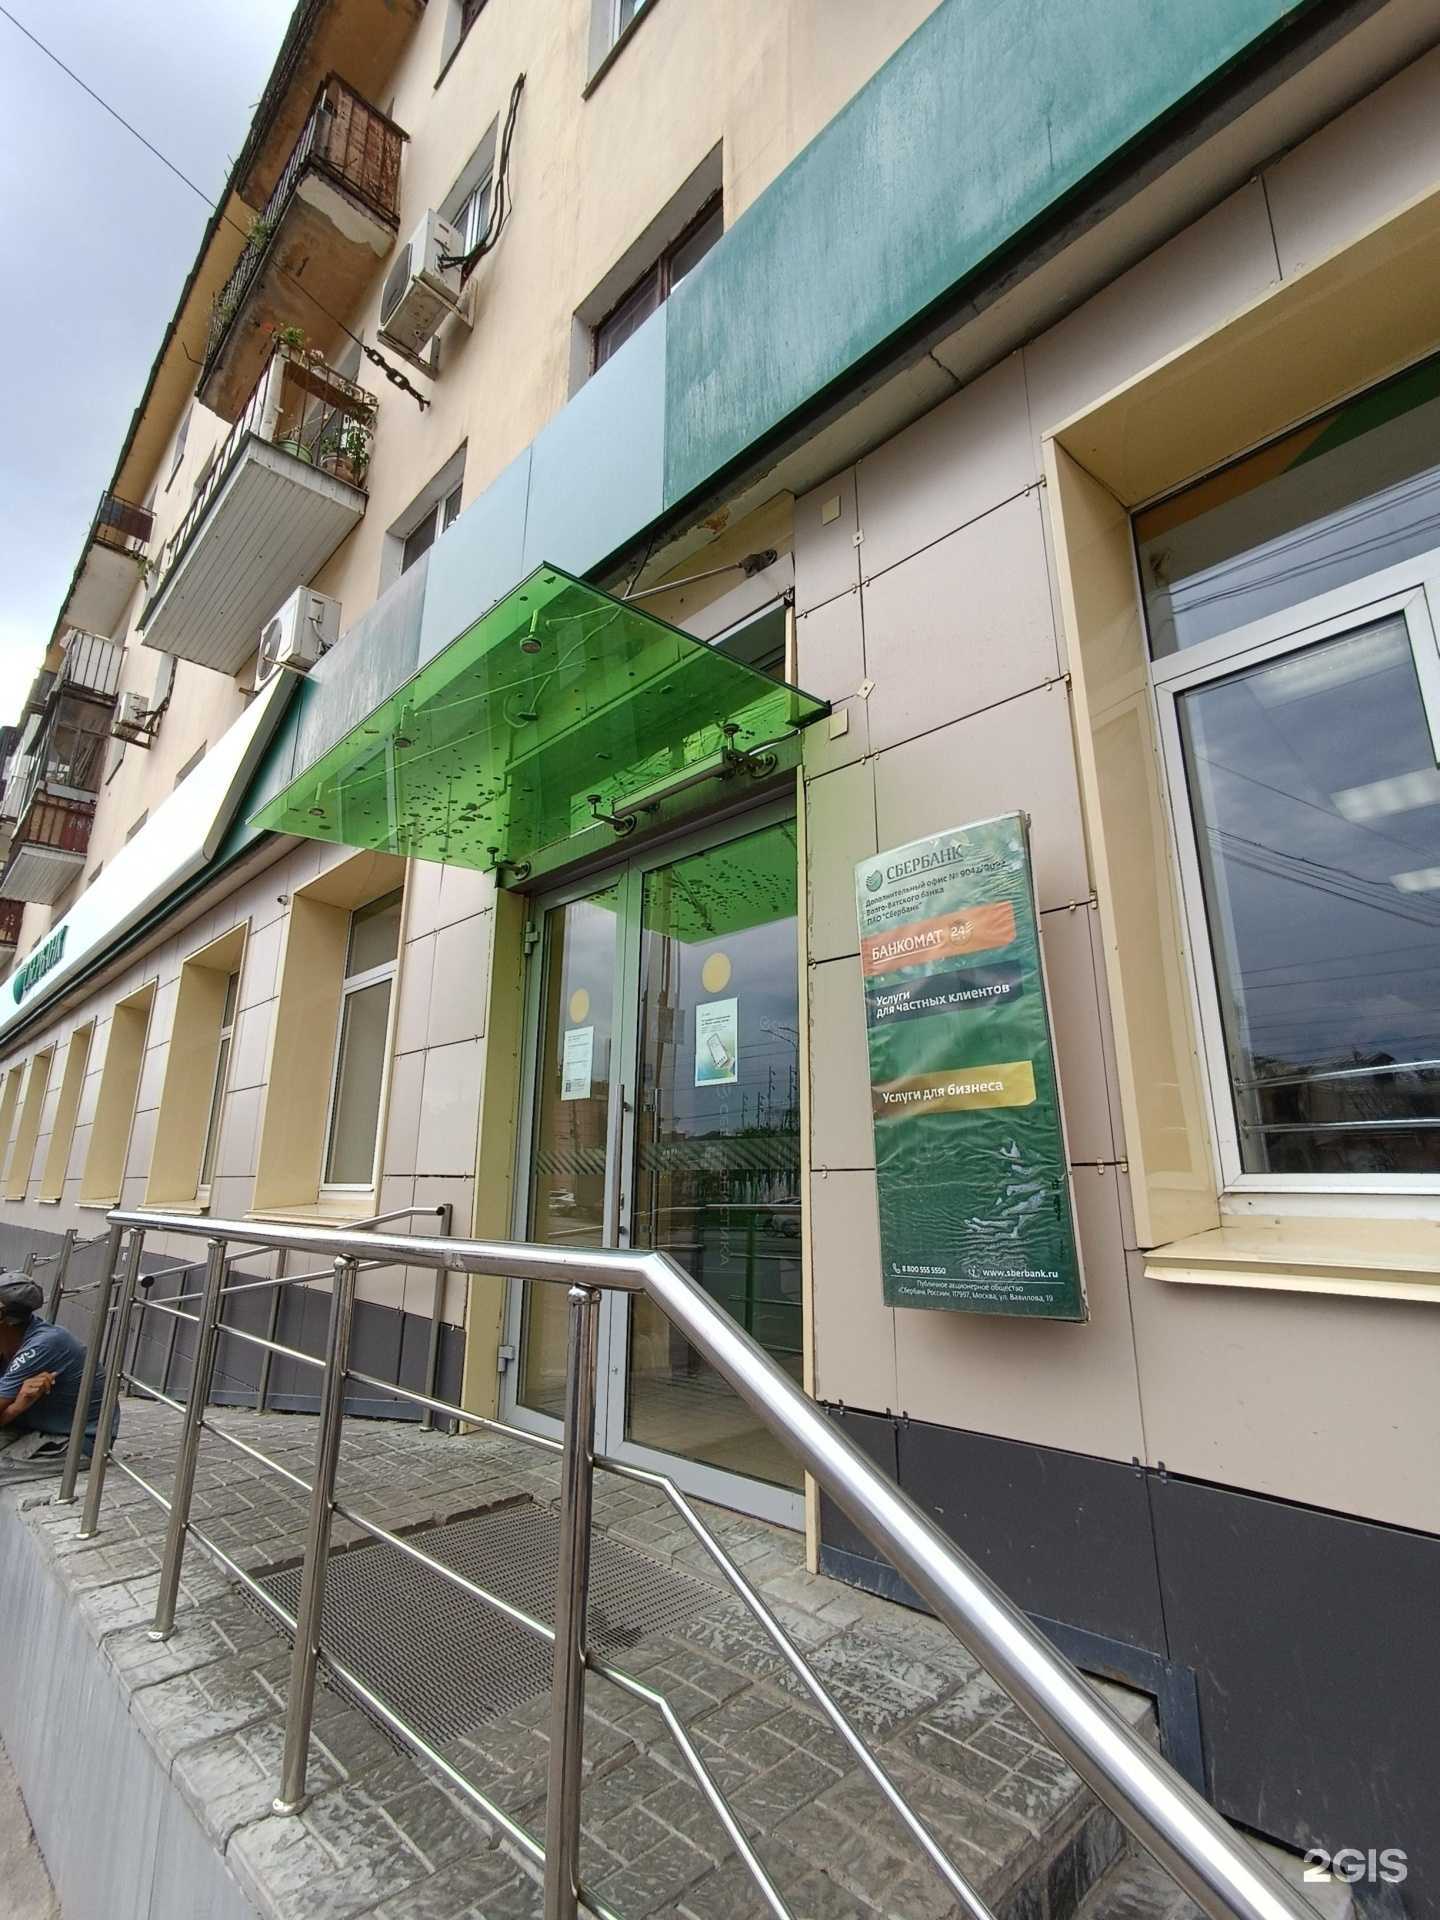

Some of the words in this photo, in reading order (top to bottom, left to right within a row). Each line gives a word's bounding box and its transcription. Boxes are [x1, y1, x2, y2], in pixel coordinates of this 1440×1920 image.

[886, 845, 964, 880] СБЕРБАНК
[872, 929, 943, 961] БАНКОМАТ
[876, 991, 911, 1006] Услуги
[876, 1005, 895, 1019] для
[895, 994, 947, 1013] частных
[948, 984, 1011, 1003] клиентов
[882, 1090, 921, 1104] Услуги
[922, 1087, 945, 1101] для
[947, 1080, 1004, 1096] бизнеса
[982, 1268, 1058, 1278] www.sberbank.ru
